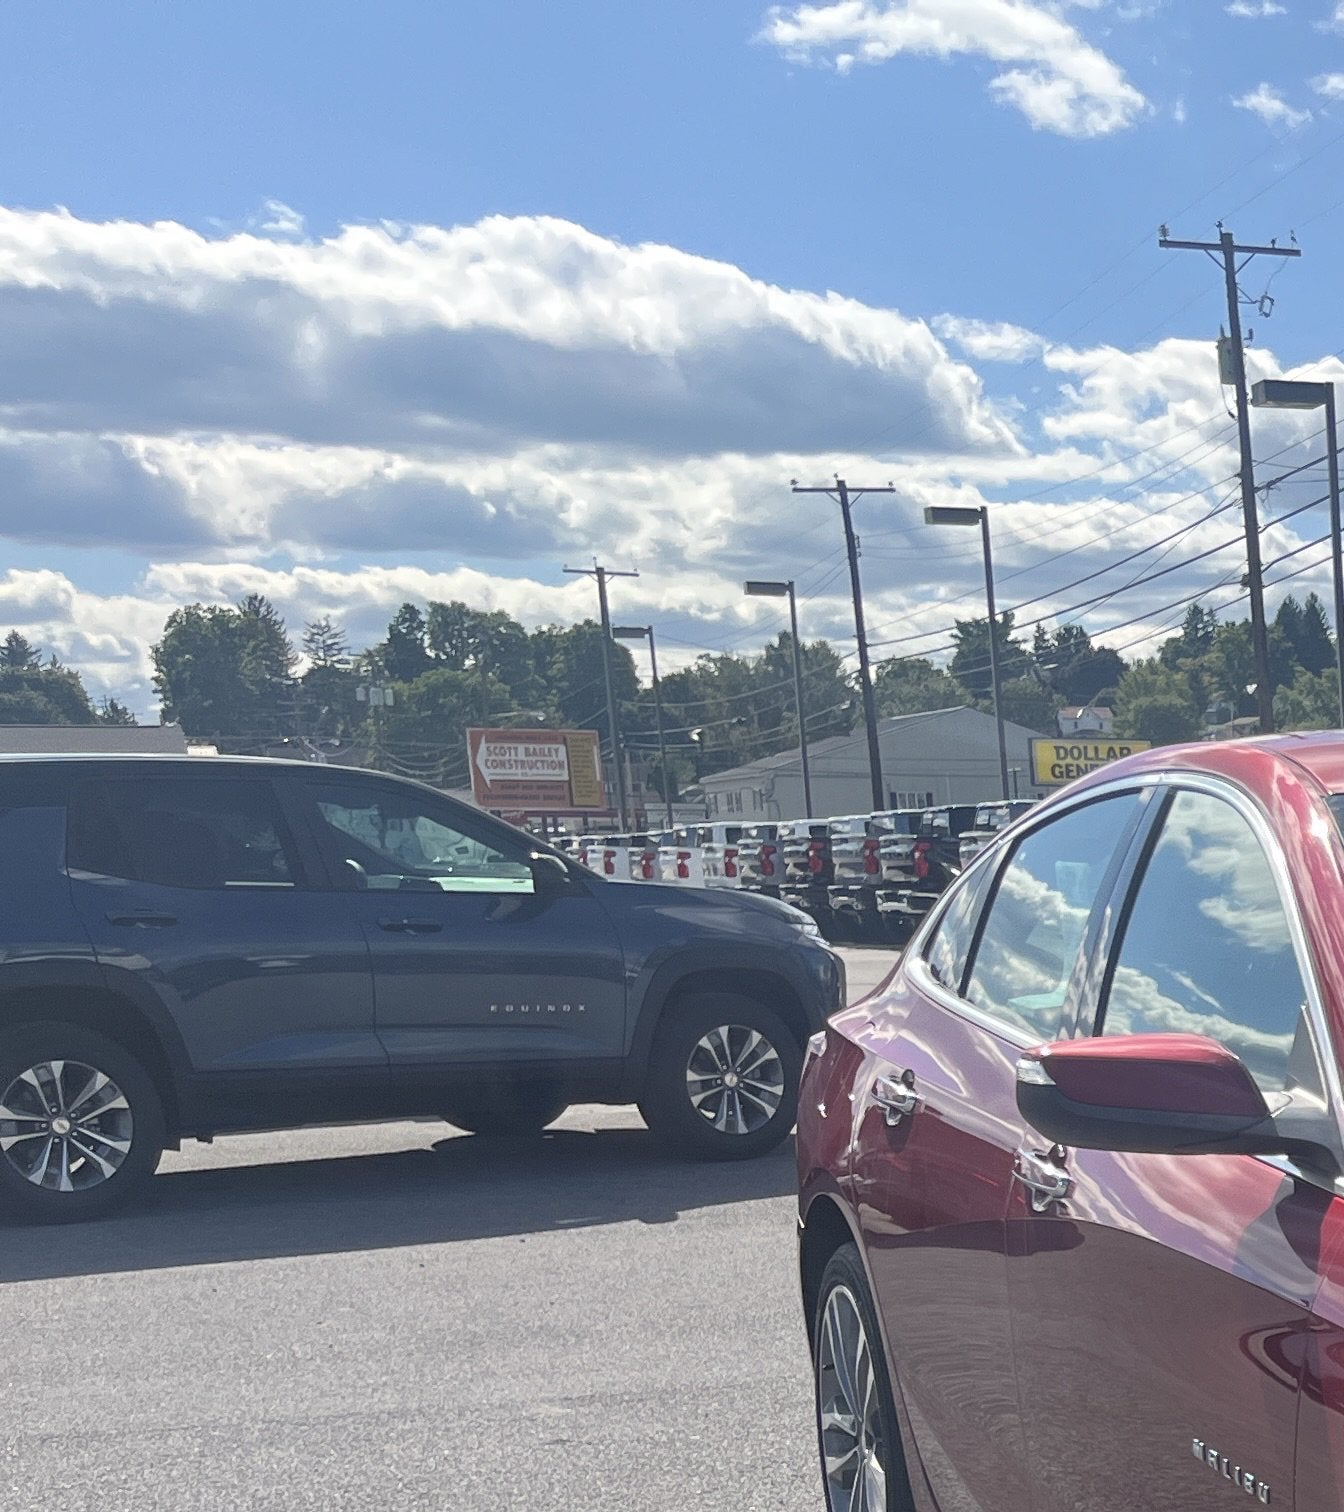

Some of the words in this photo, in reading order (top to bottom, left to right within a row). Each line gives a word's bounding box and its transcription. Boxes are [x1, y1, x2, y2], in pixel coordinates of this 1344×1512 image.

[486, 746, 519, 757] SCOTT
[524, 746, 560, 757] BAILEY
[484, 759, 565, 770] CONSTRUCTION
[490, 1004, 586, 1012] EQUINOX
[1192, 1438, 1271, 1504] MALIBU
